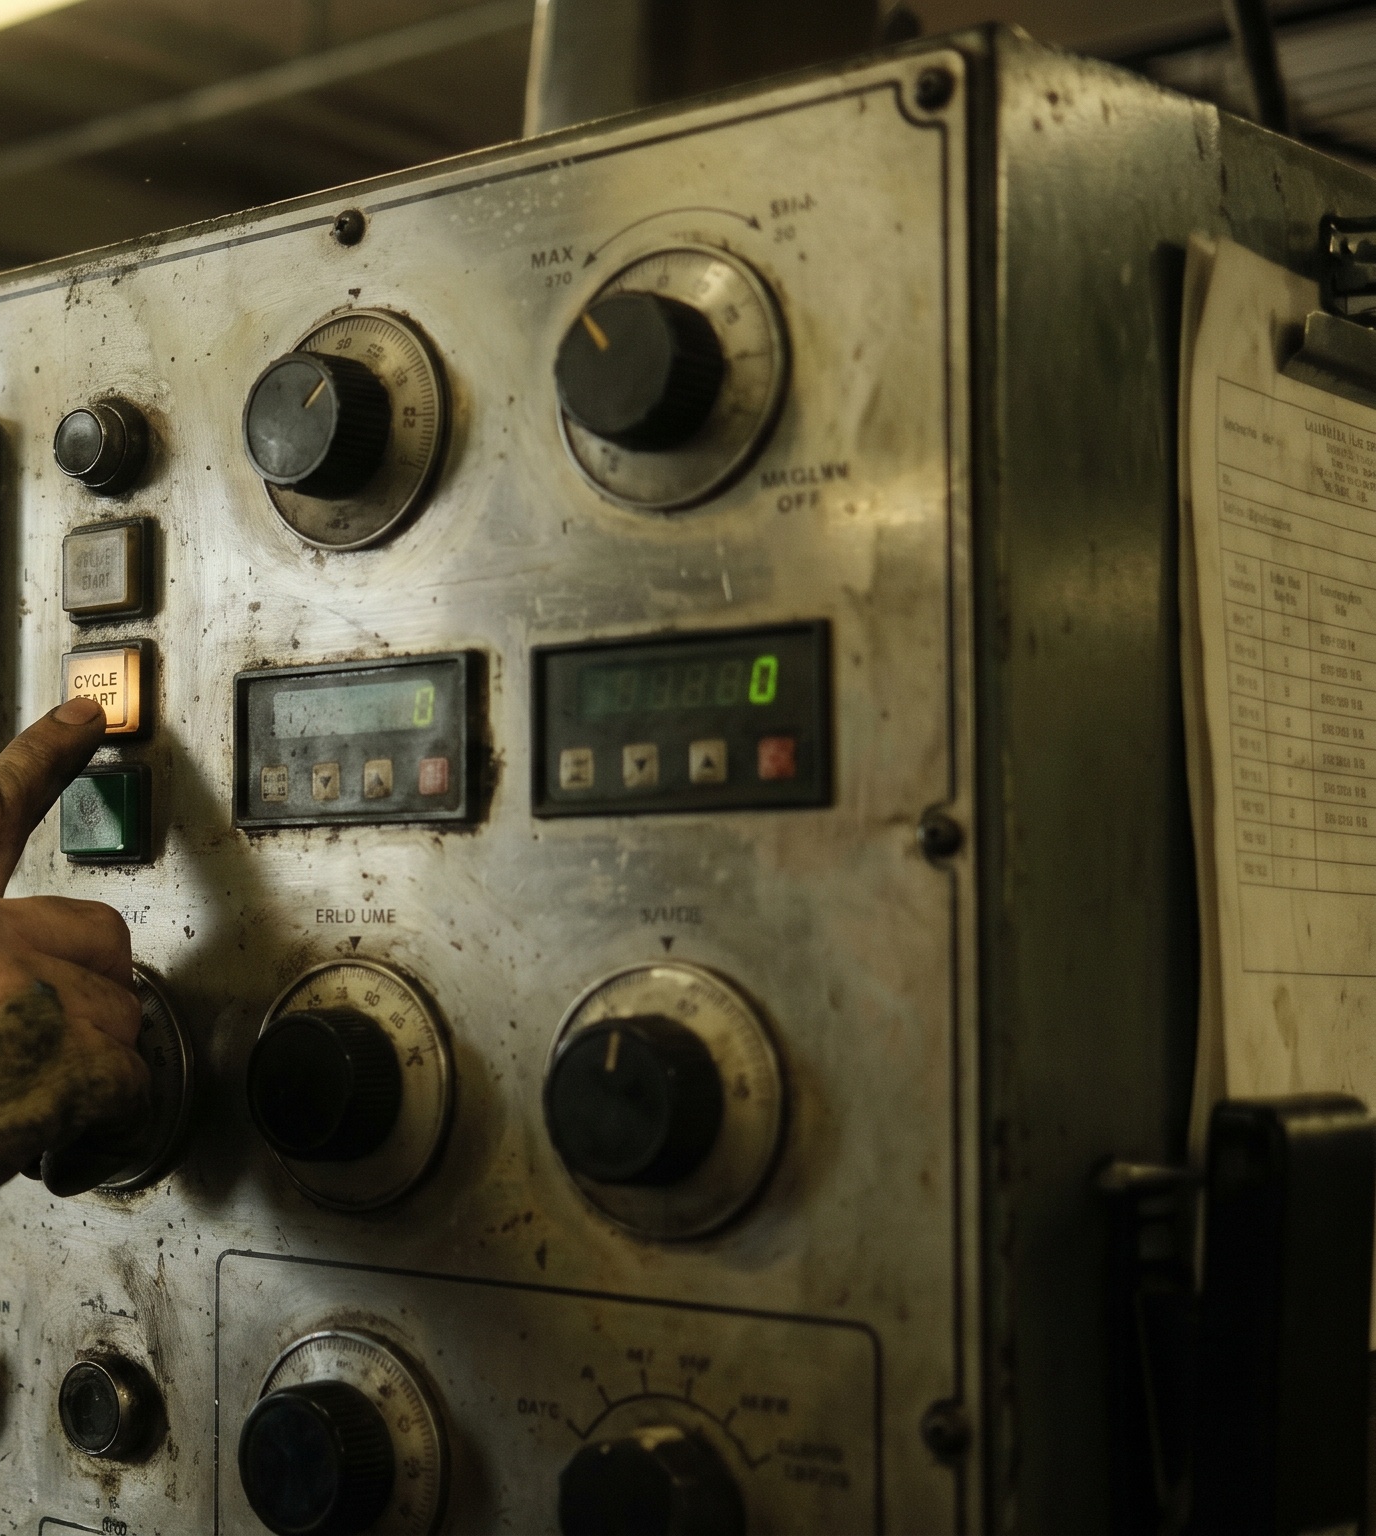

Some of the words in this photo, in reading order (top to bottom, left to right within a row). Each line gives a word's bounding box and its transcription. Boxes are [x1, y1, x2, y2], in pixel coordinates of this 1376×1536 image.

[531, 246, 573, 269] MAX
[74, 672, 117, 689] CYCLE
[749, 656, 778, 704] 0
[75, 692, 117, 706] ART
[413, 686, 434, 726] 0
[316, 908, 356, 924] ERLD
[361, 908, 397, 924] UME
